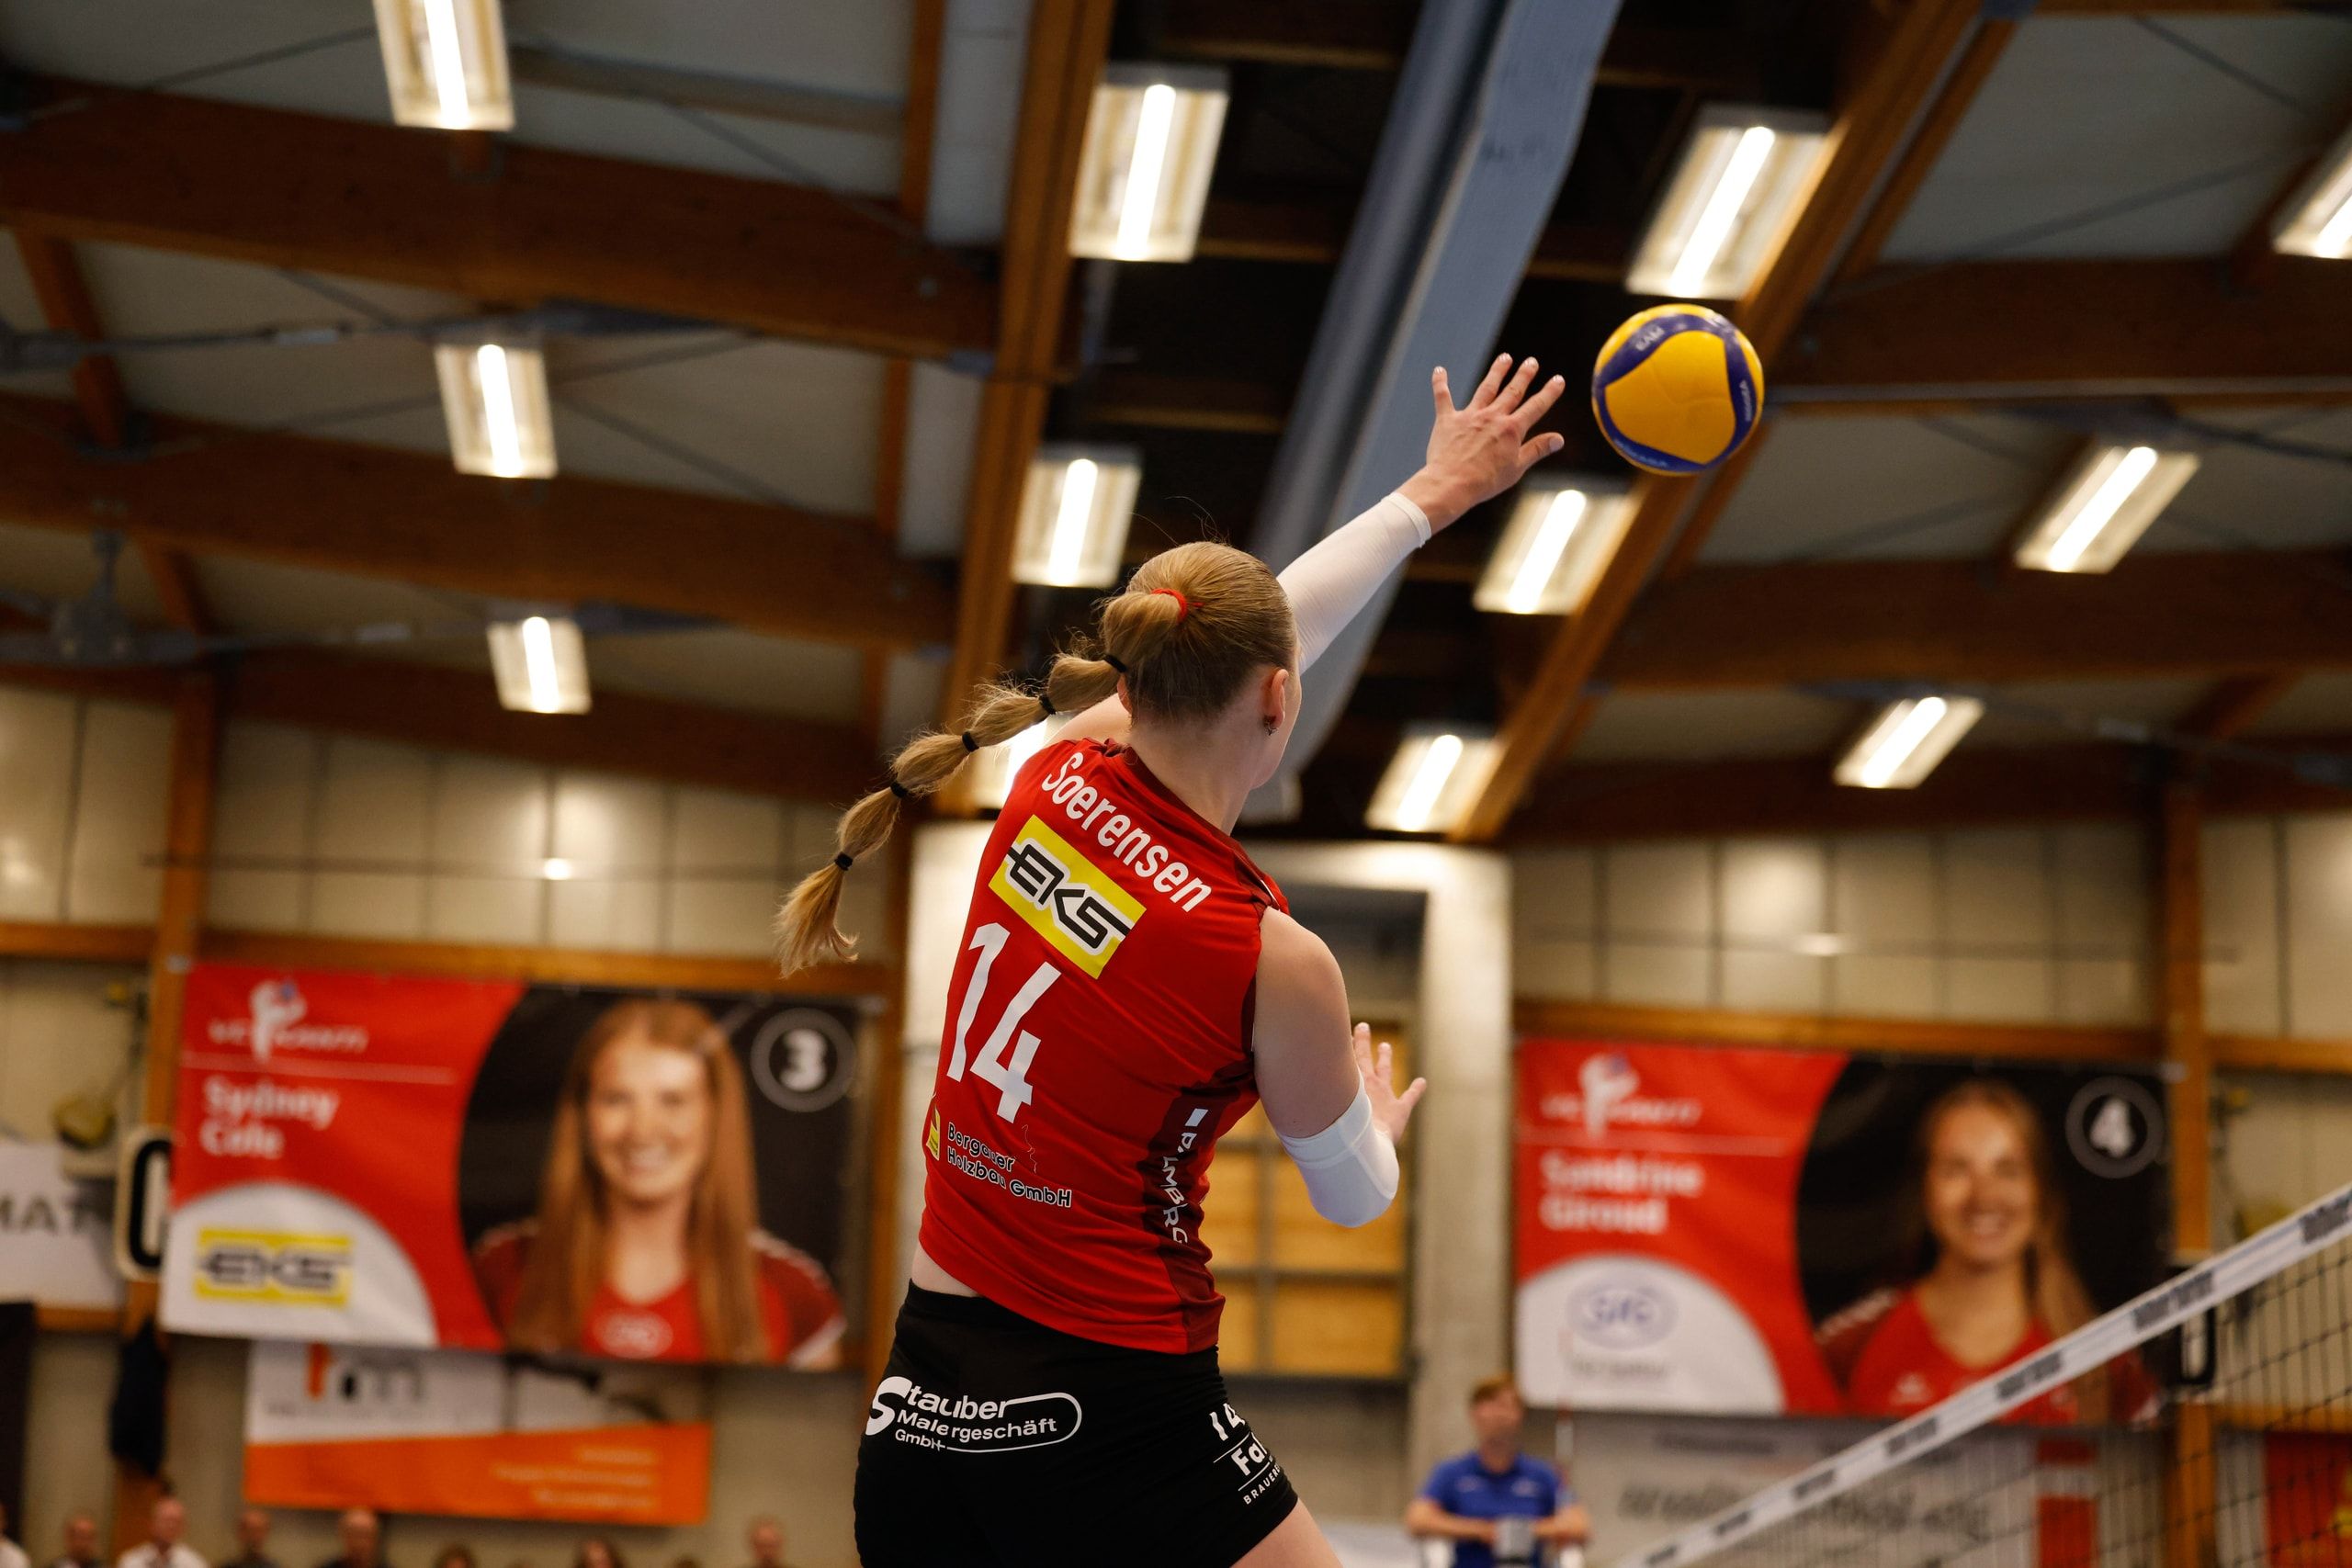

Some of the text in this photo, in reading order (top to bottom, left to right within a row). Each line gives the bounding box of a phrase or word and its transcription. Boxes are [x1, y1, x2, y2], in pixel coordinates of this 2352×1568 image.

[1042, 751, 1213, 913] Soerensen
[946, 922, 1061, 1123] 14
[781, 1028, 827, 1091] 3
[947, 1122, 1015, 1173] Bergauer
[2090, 1097, 2133, 1157] 4
[947, 1145, 1007, 1190] Holzbau
[1010, 1179, 1072, 1208] GmbH
[865, 1376, 1009, 1436] Stauber
[897, 1409, 1057, 1443] Malergeschäft
[1209, 1403, 1246, 1441] 14
[895, 1428, 941, 1451] GmbH
